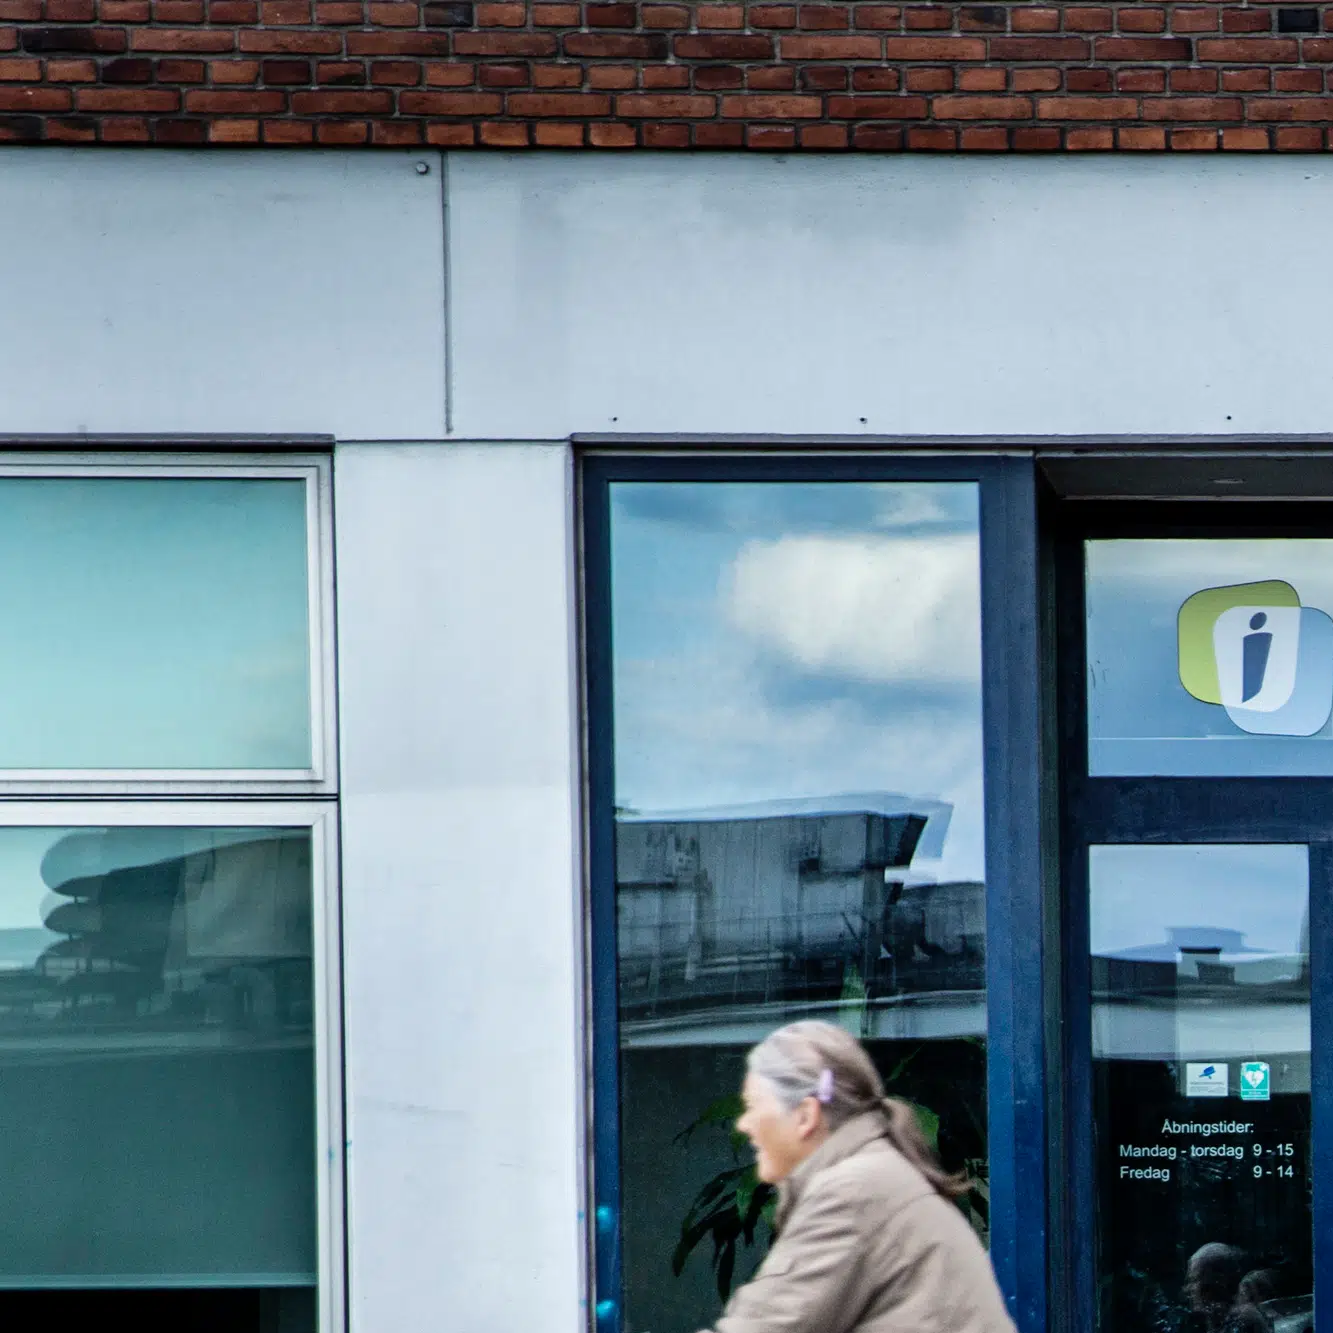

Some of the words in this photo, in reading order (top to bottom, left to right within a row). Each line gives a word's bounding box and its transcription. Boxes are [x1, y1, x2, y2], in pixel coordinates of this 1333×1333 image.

[1162, 1118, 1254, 1135] Åbningstider:
[1120, 1144, 1177, 1160] Mandag
[1191, 1143, 1244, 1160] torsdag
[1253, 1143, 1262, 1156] 9
[1277, 1143, 1294, 1156] 15
[1120, 1166, 1170, 1182] Fredag
[1253, 1166, 1262, 1178] 9
[1277, 1166, 1294, 1178] 14
